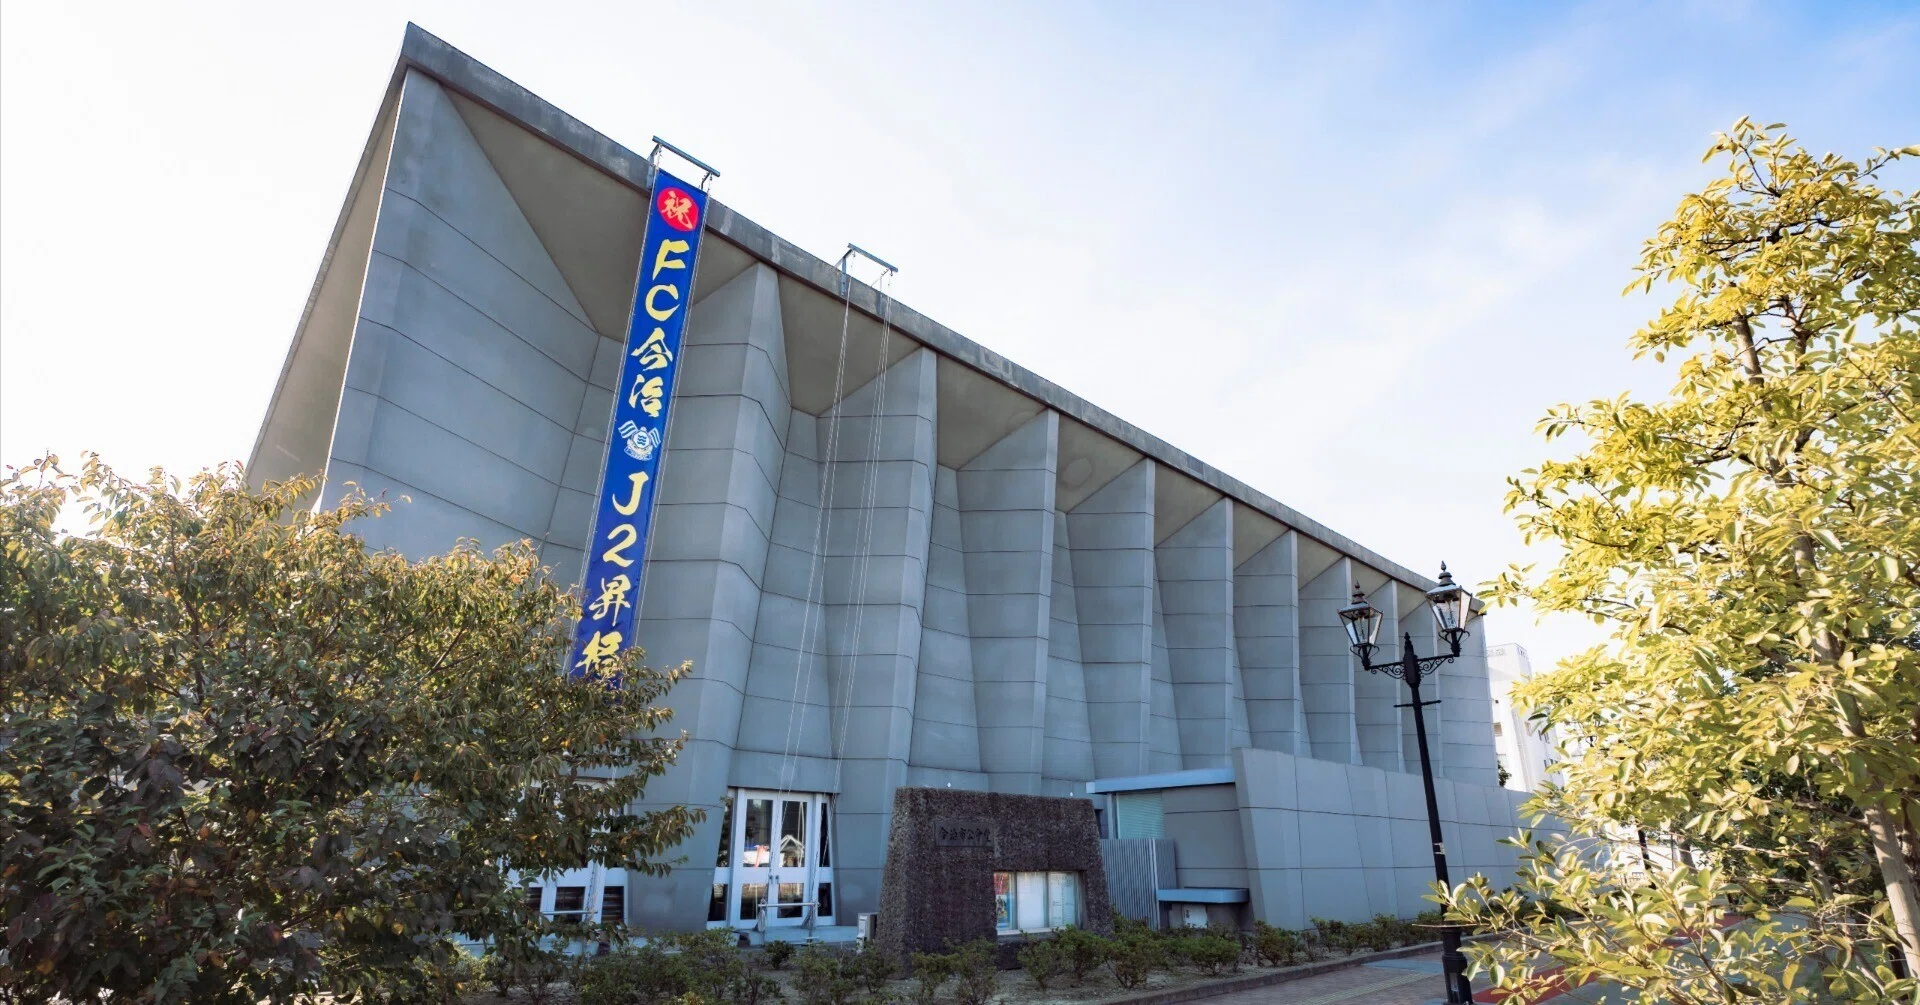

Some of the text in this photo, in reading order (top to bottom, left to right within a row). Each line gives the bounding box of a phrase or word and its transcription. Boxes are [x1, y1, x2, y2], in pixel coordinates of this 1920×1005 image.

[661, 190, 693, 229] 祝
[629, 239, 690, 417] FC今治
[574, 470, 650, 679] J2昇格
